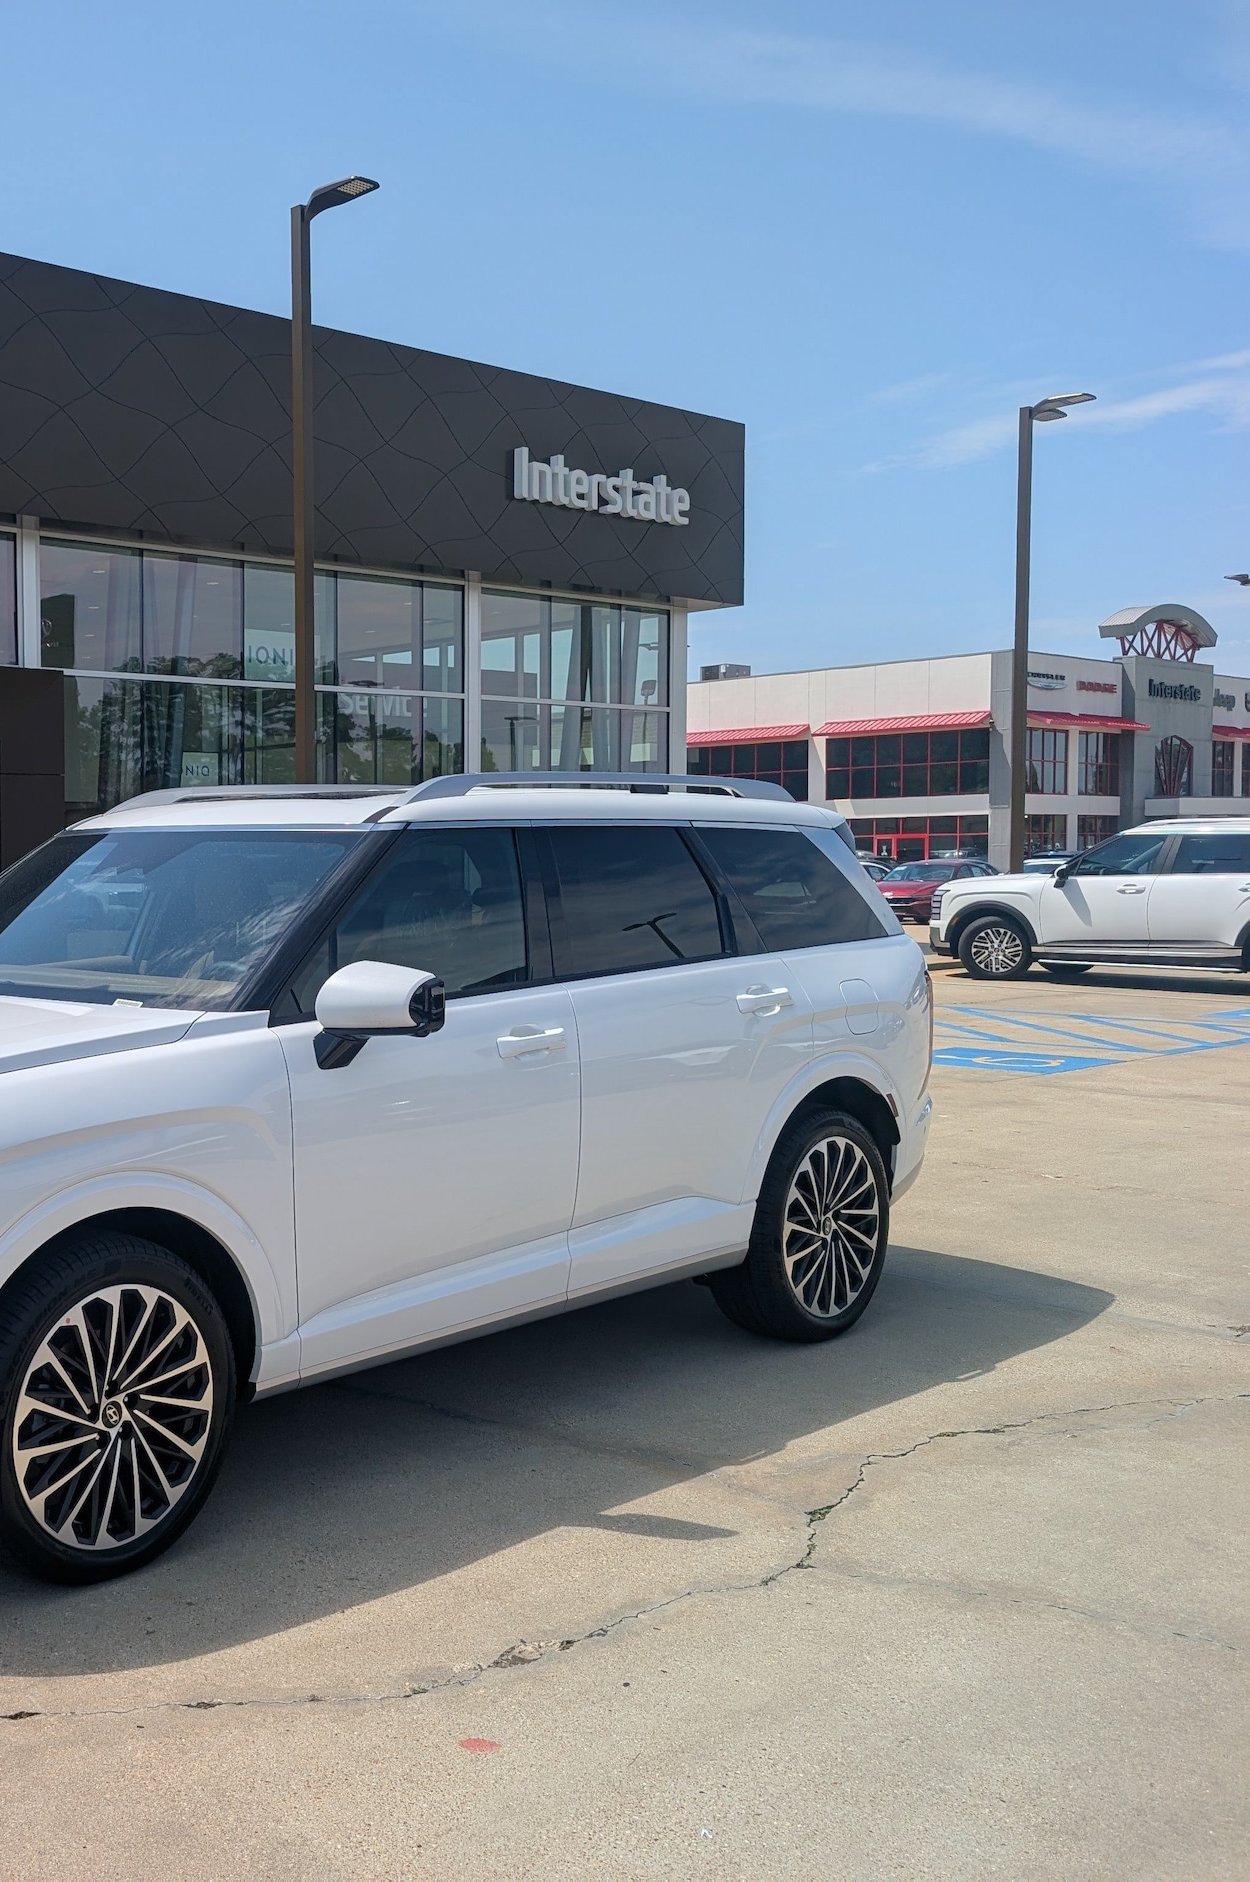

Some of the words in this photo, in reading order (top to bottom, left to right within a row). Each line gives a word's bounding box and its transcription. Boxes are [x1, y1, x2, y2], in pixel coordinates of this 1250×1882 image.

[513, 446, 691, 526] Interstate
[248, 645, 294, 666] IONI
[1076, 680, 1118, 694] DODGE
[1148, 678, 1202, 701] Interstate
[184, 765, 210, 777] NIQ
